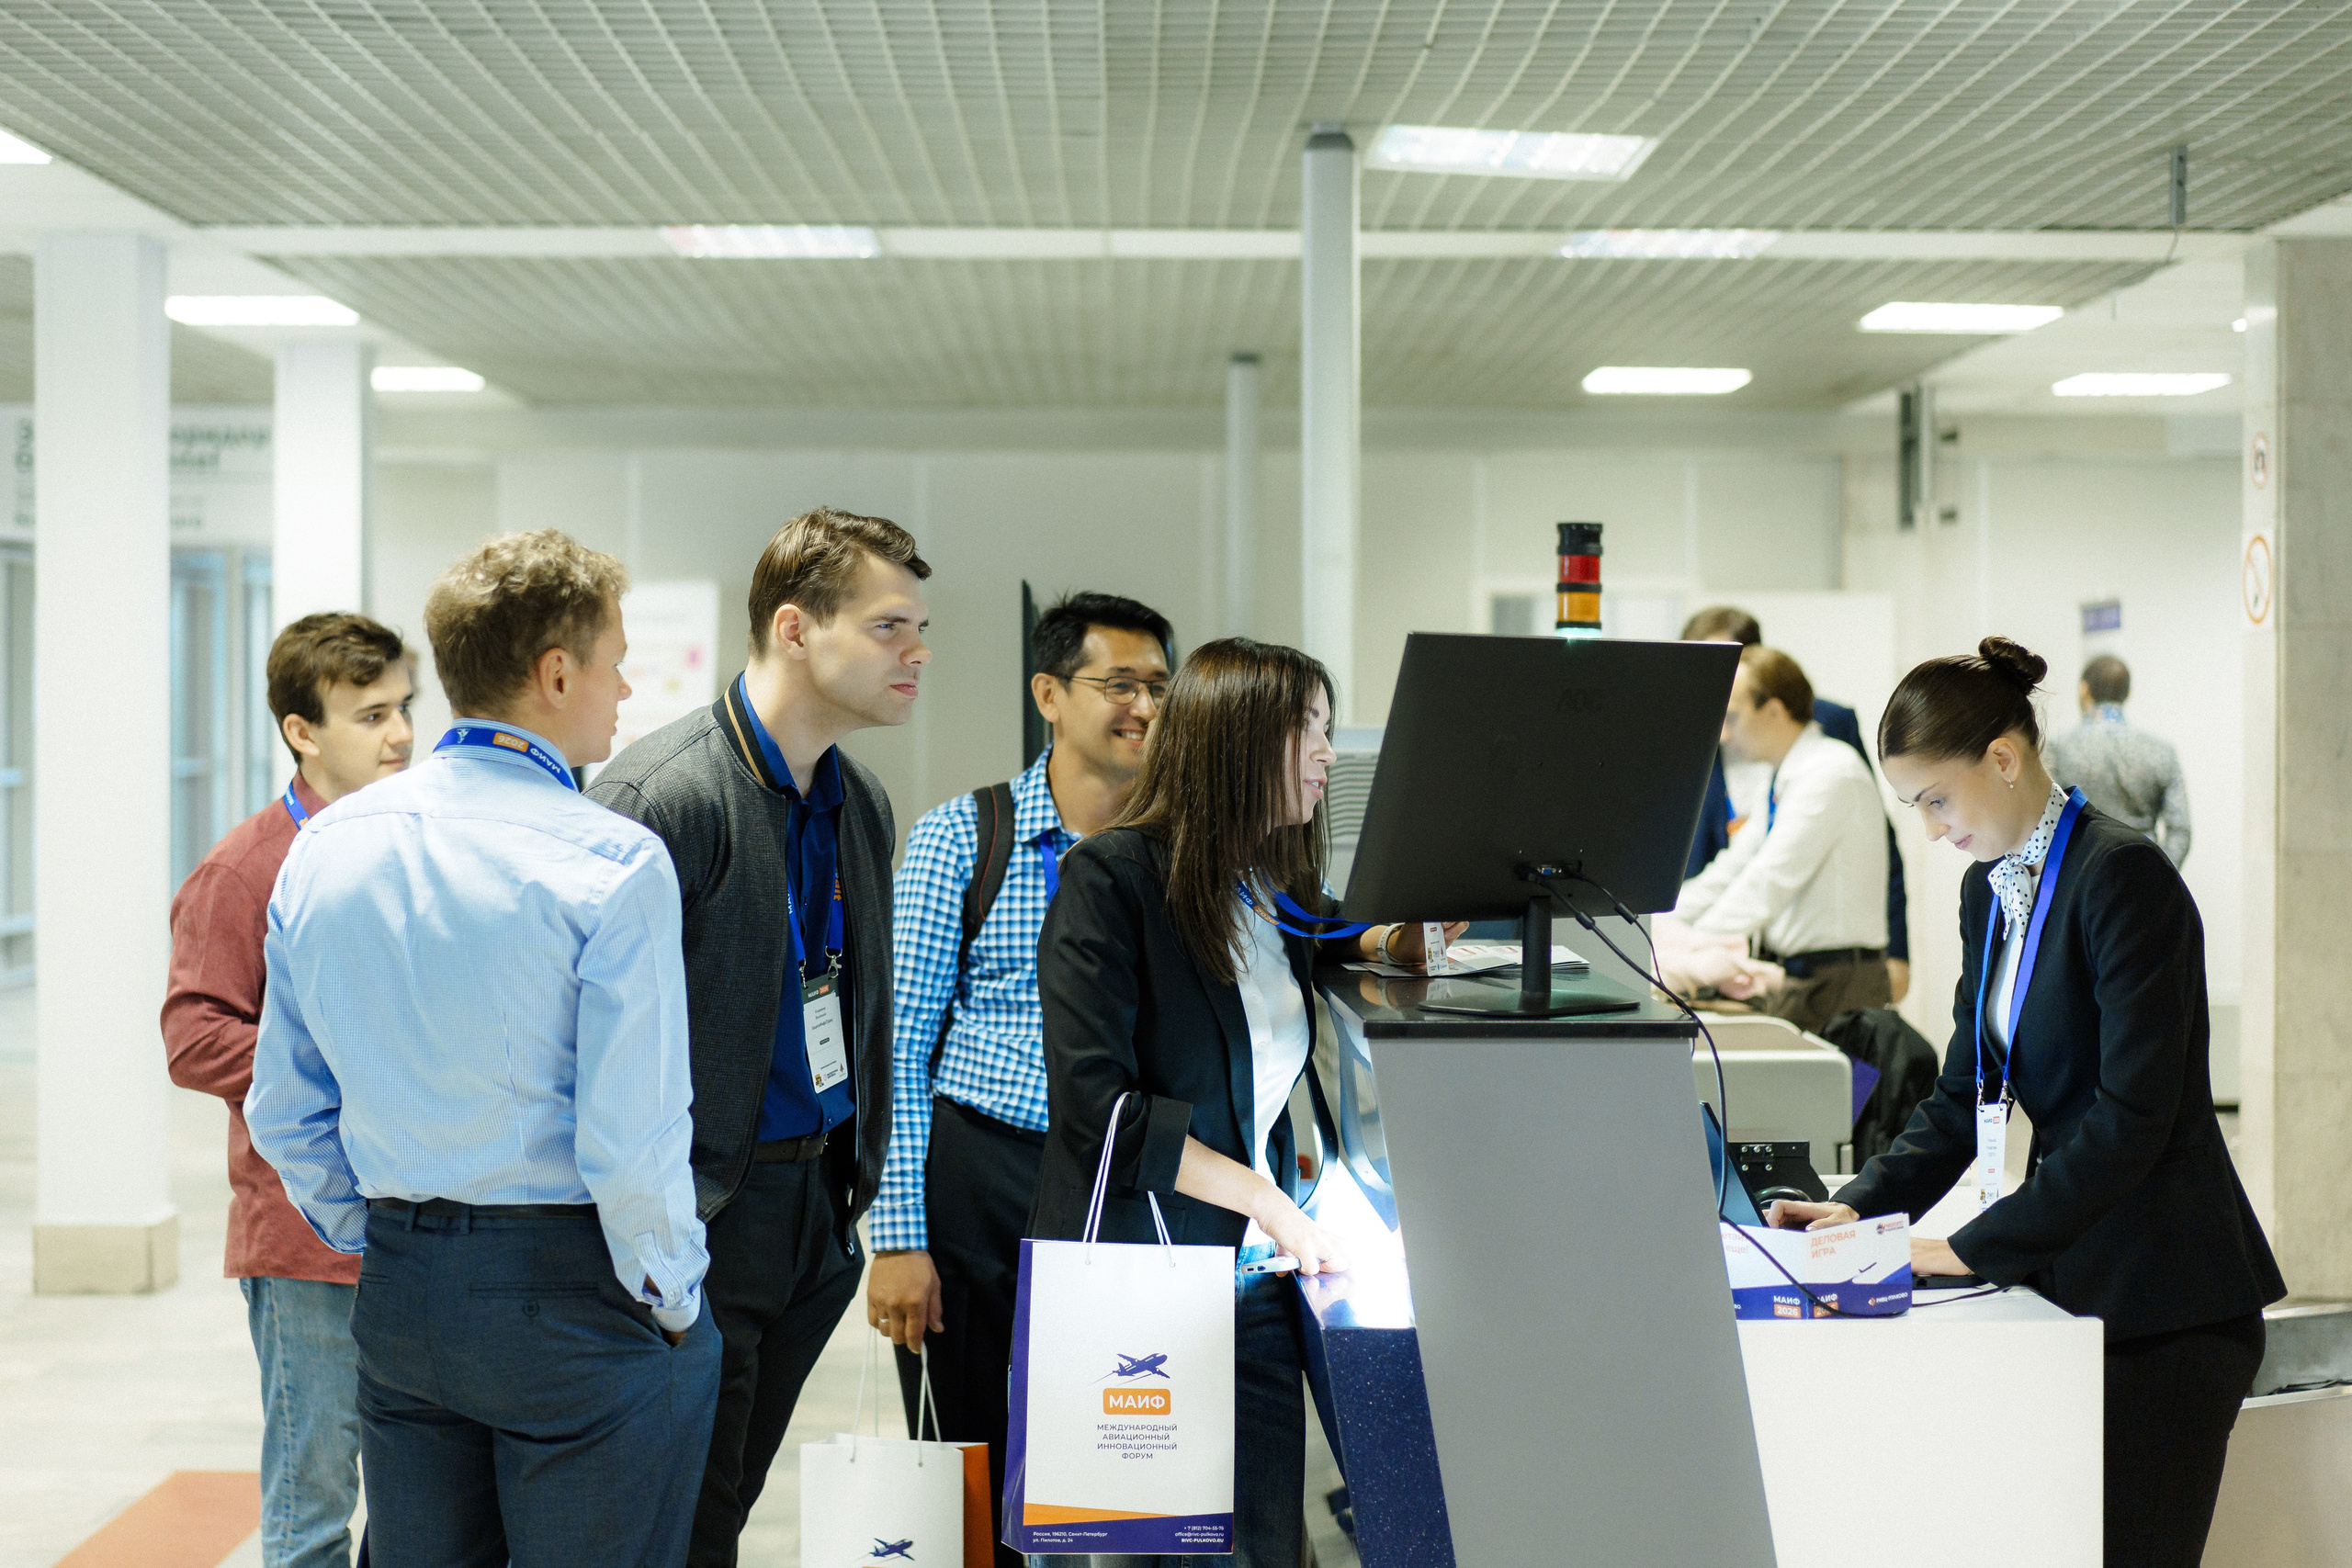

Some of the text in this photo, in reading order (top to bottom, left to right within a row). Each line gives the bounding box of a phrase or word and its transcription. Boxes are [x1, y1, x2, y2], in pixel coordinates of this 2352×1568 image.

[498, 735, 561, 773] МАИФ 2026
[1811, 1230, 1856, 1248] ДЕЛОВАЯ
[1811, 1248, 1837, 1259] ИГРА
[1773, 1295, 1801, 1305] МАИФ
[1814, 1293, 1838, 1304] АИФ
[1777, 1306, 1799, 1316] 2026
[1109, 1394, 1166, 1409] МАИФ
[1097, 1424, 1178, 1432] МЕЖДУНАРОДНЫЙ
[1102, 1433, 1170, 1441] АВИАЦИОННЫЙ
[1097, 1442, 1177, 1450] ИННОВАЦИОННЫЙ
